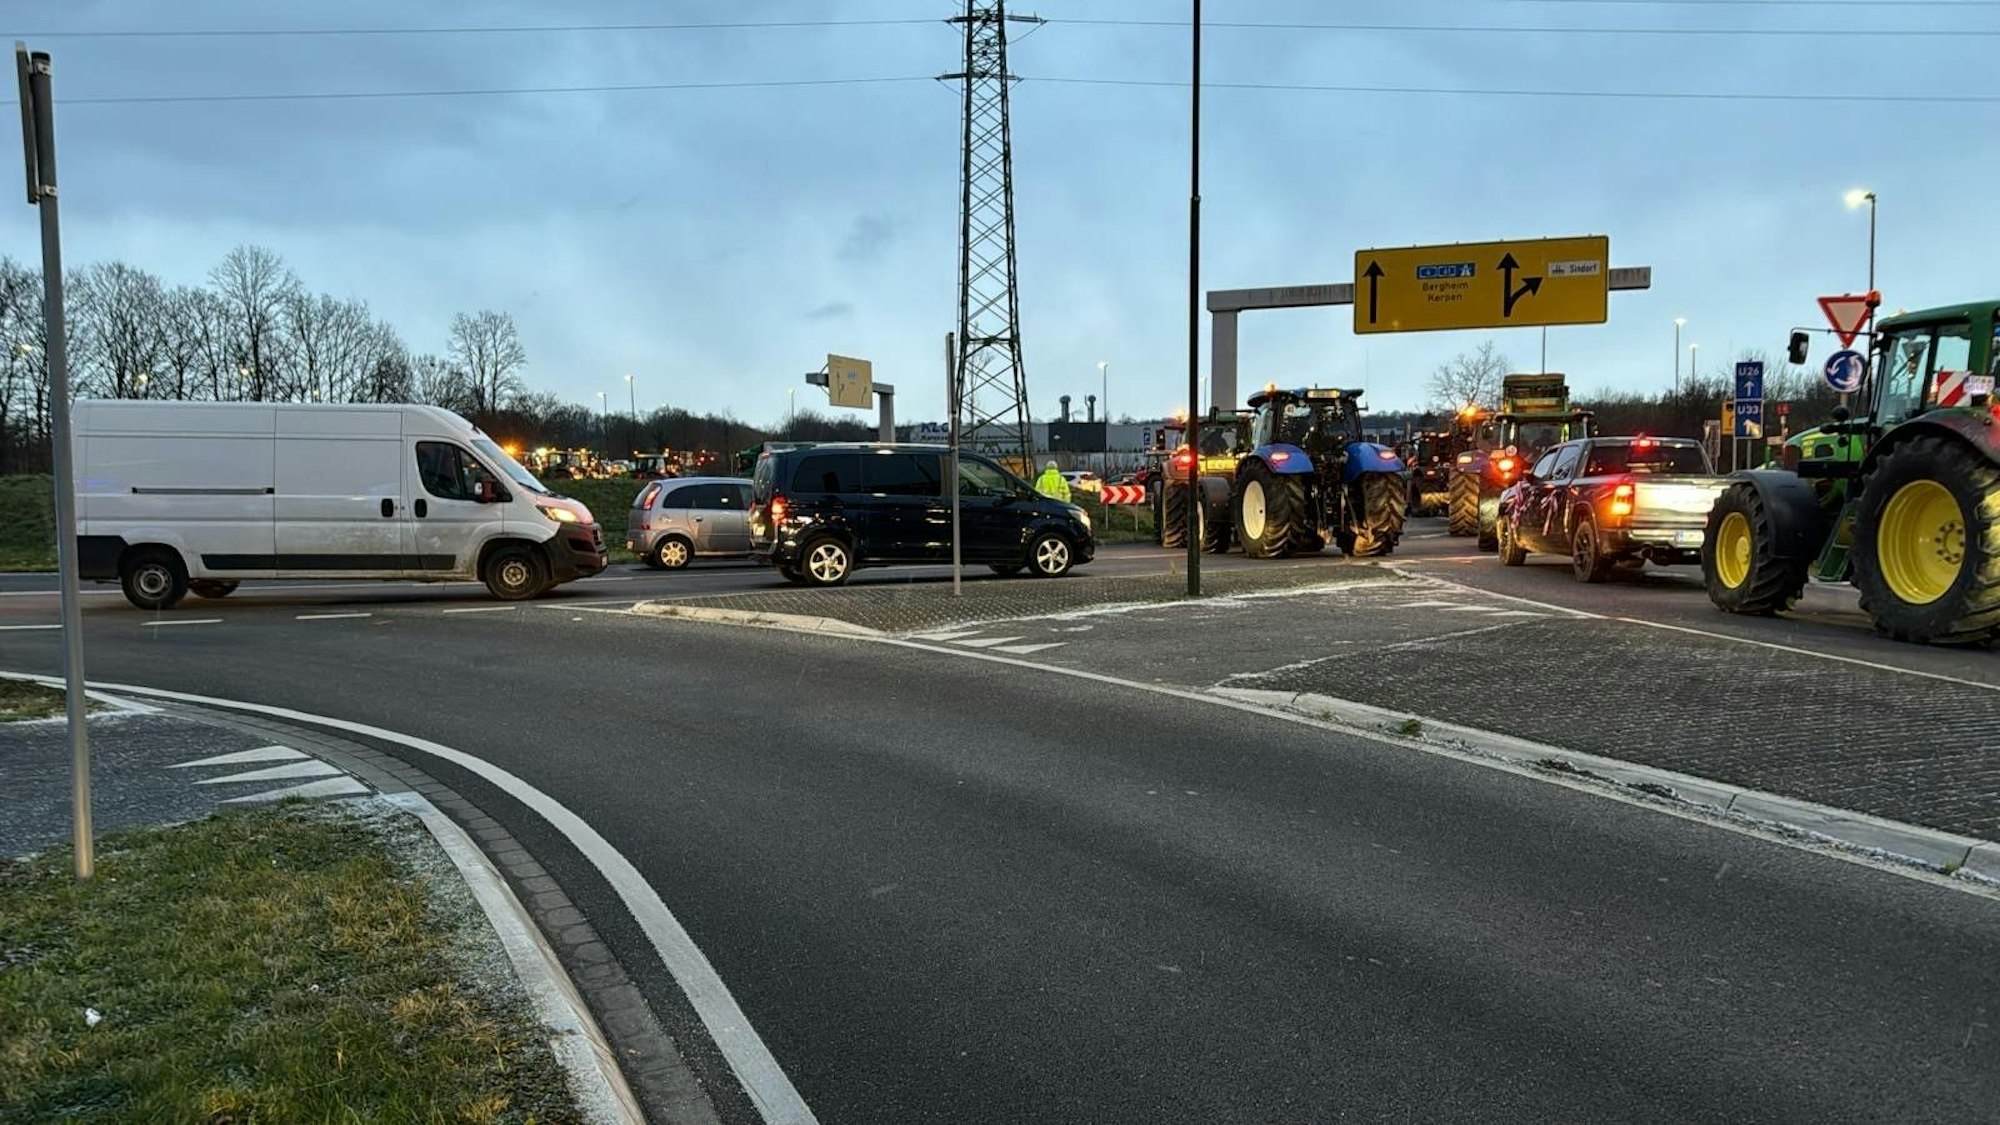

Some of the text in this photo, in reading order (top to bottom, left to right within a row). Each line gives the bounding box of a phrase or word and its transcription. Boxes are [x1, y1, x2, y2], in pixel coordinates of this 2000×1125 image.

[1569, 263, 1598, 273] Sindorf
[1422, 281, 1469, 292] Bergheim
[1428, 294, 1463, 302] Kerpen
[1738, 366, 1760, 376] U26
[1737, 405, 1759, 415] U33
